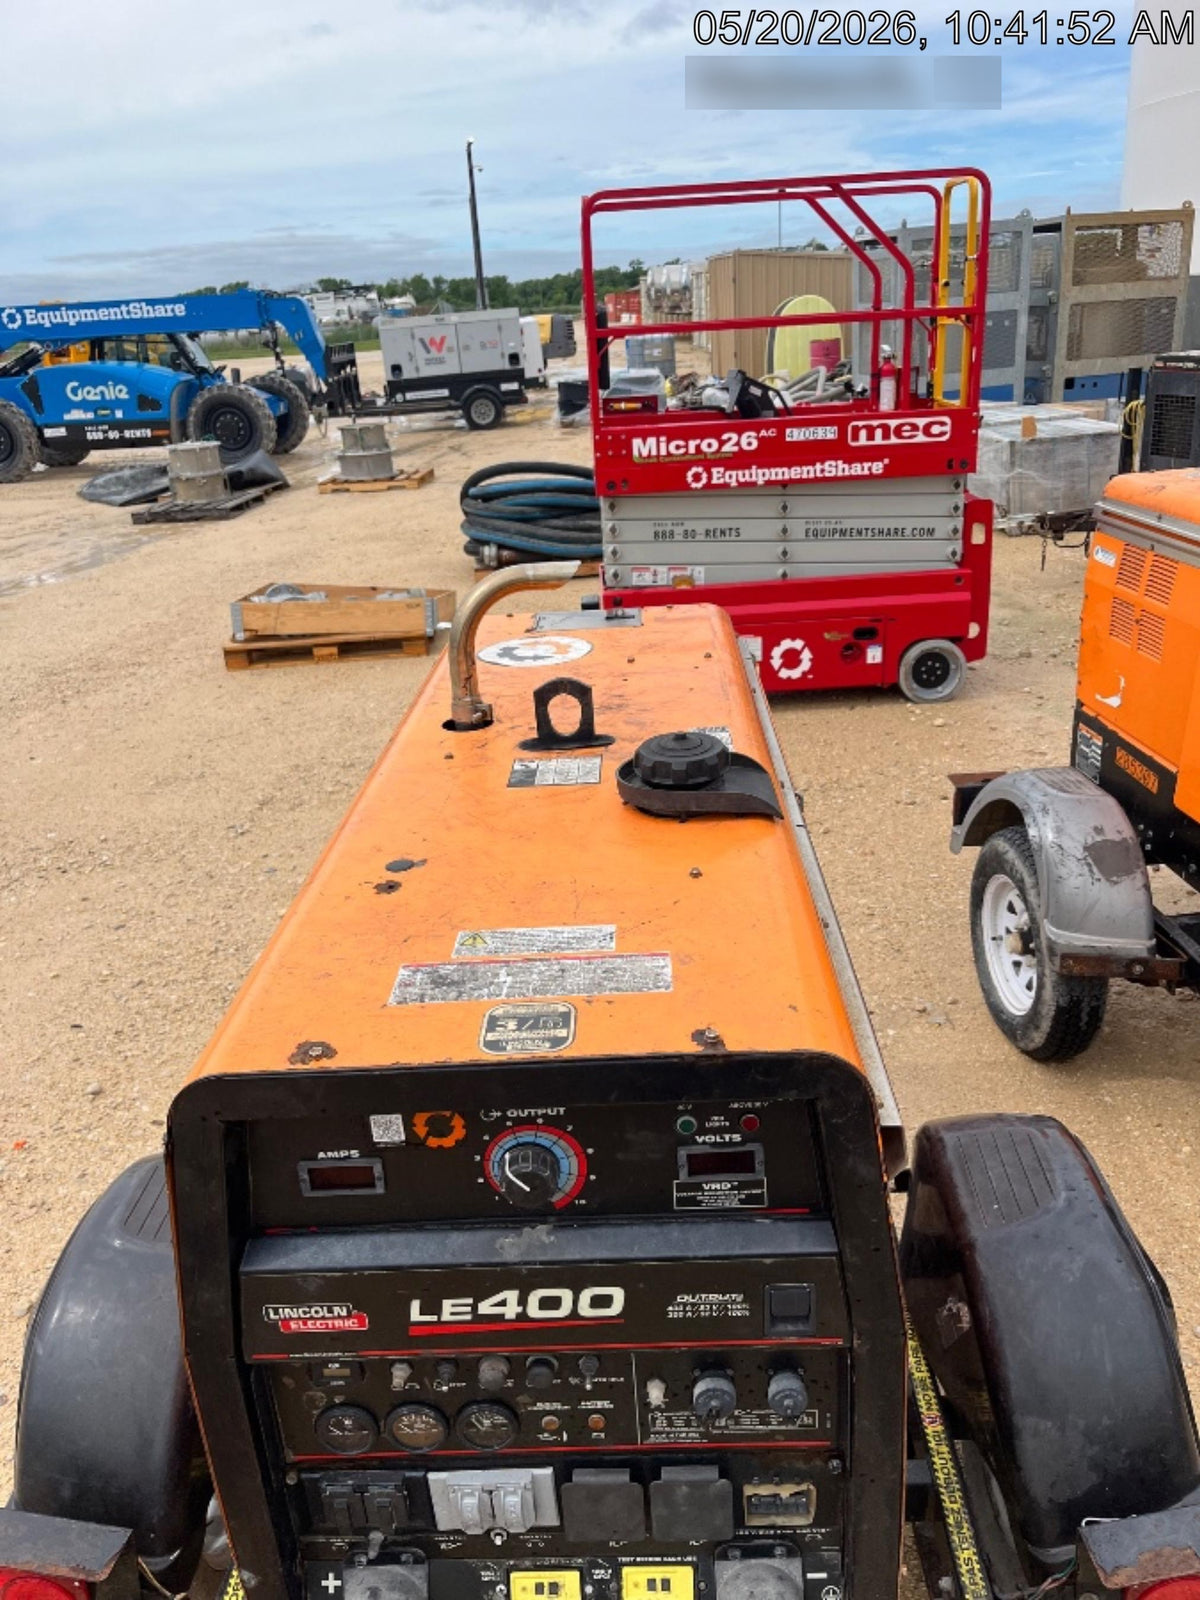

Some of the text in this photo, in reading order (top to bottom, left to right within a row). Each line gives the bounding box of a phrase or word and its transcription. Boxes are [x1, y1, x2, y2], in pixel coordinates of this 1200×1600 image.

[24, 302, 186, 327] EquipmentShare
[65, 381, 130, 401] Genie
[850, 420, 949, 443] mec
[653, 527, 741, 540] 888-80-RENTS
[804, 526, 936, 540] EQUIPMENTSHARE.COM
[506, 1107, 566, 1117] OUTPUT
[694, 1133, 743, 1144] VOLTS
[317, 1149, 360, 1160] AMPS
[410, 1286, 626, 1322] LE400
[269, 1305, 348, 1320] LINCOLN
[289, 1318, 359, 1330] ELECTRIC
